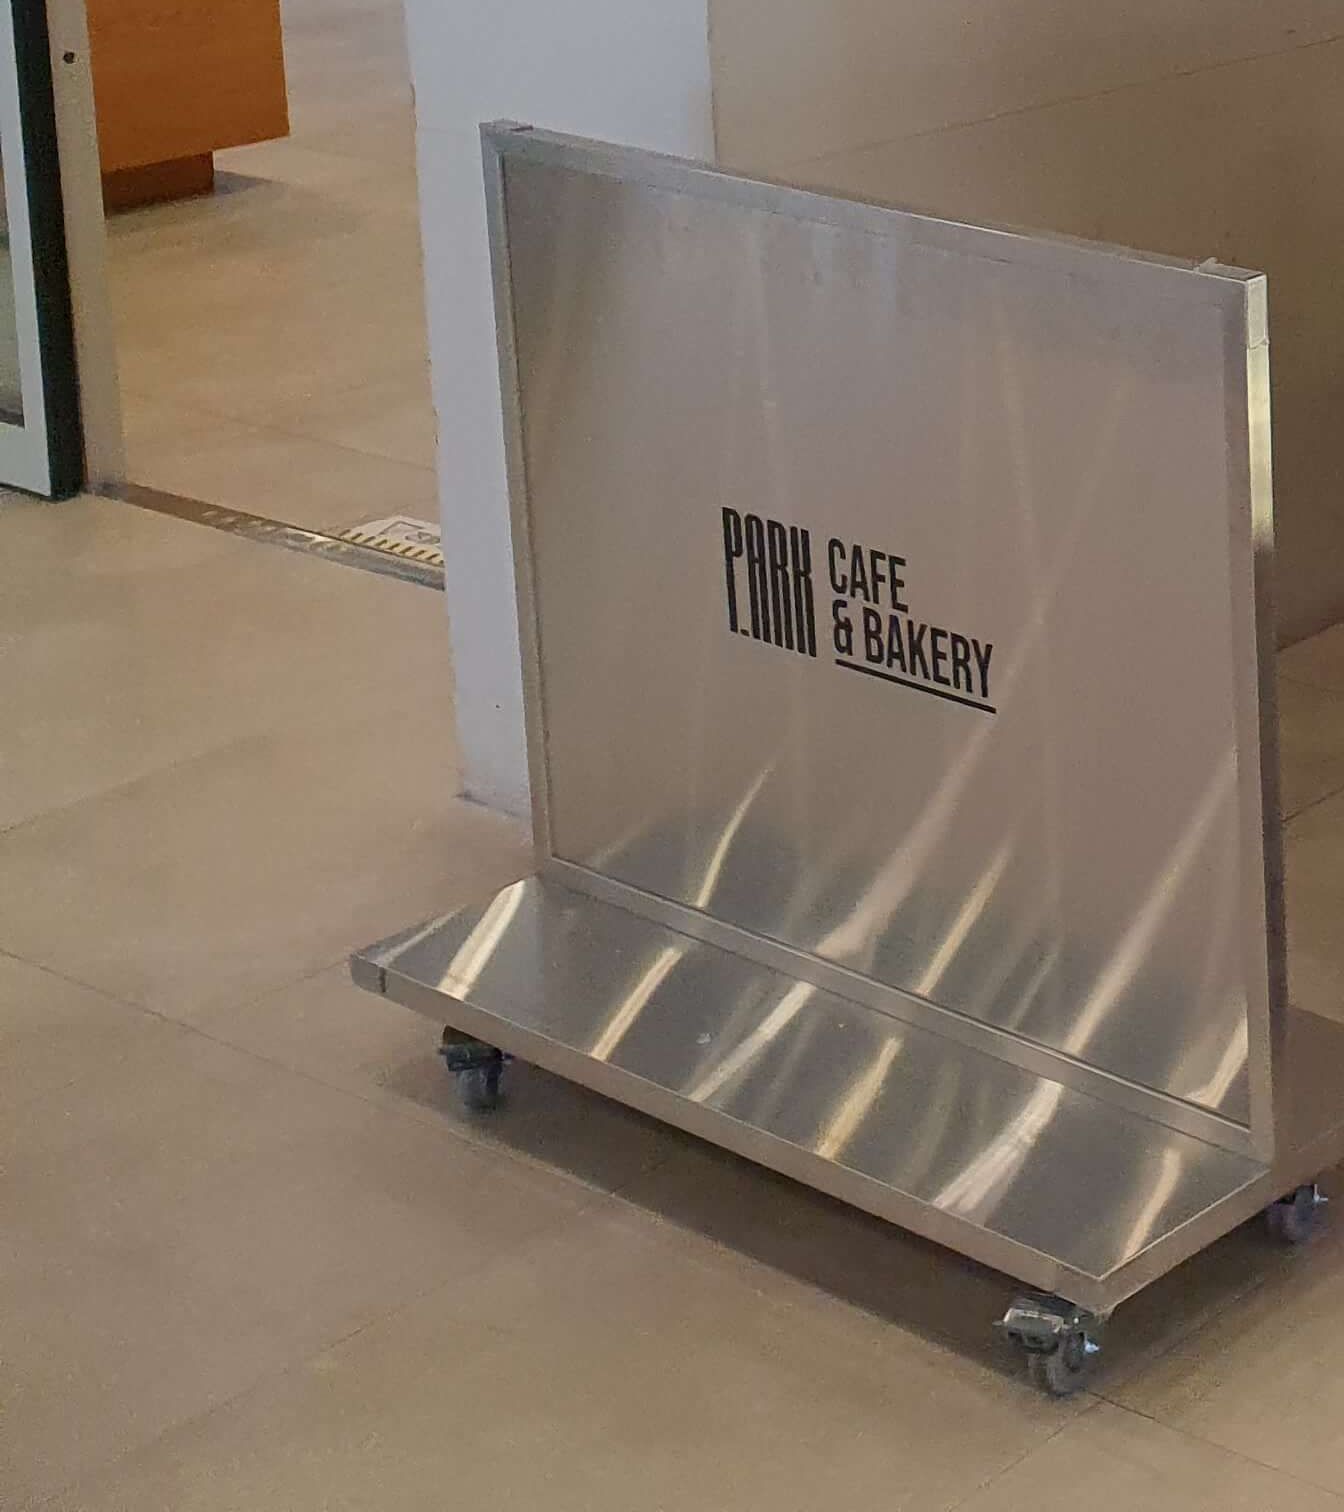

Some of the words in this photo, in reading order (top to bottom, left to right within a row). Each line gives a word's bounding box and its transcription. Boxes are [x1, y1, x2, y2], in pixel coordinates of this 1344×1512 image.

[721, 506, 817, 658] PARK
[827, 538, 909, 614] CAFE
[831, 599, 854, 657] &
[862, 606, 993, 699] BAKERY
